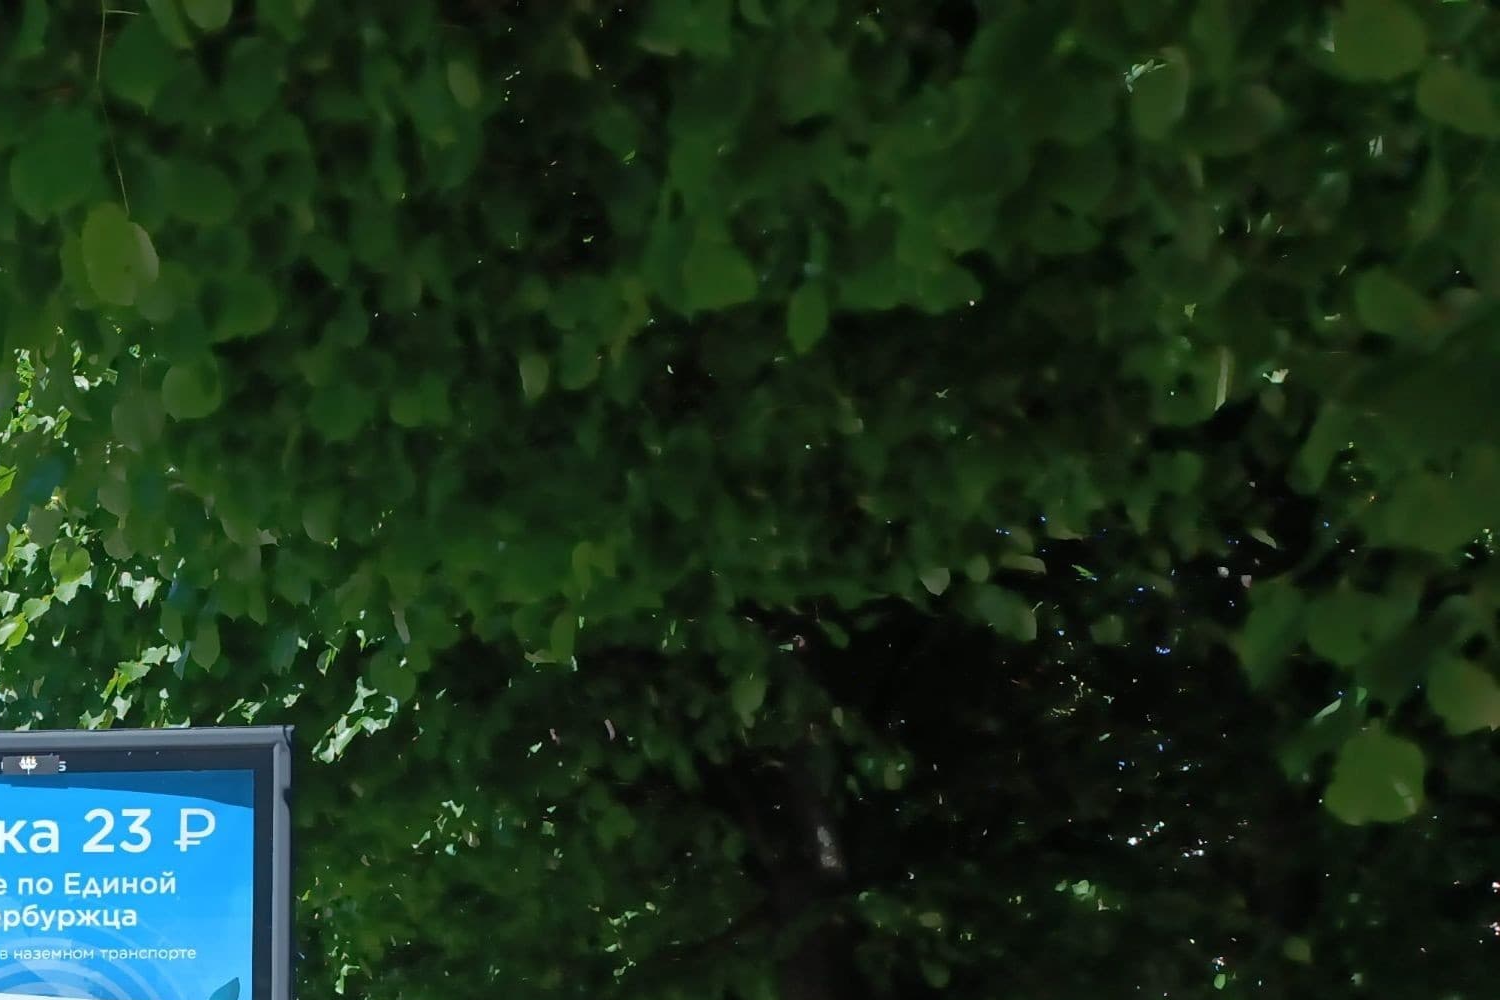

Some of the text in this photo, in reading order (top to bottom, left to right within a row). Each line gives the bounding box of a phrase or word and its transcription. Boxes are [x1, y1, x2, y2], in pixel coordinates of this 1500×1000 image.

[82, 807, 152, 854] 23
[17, 877, 54, 896] по
[64, 871, 176, 899] Единой
[0, 950, 8, 961] в
[13, 949, 94, 961] наземном
[99, 949, 197, 962] транспорте
